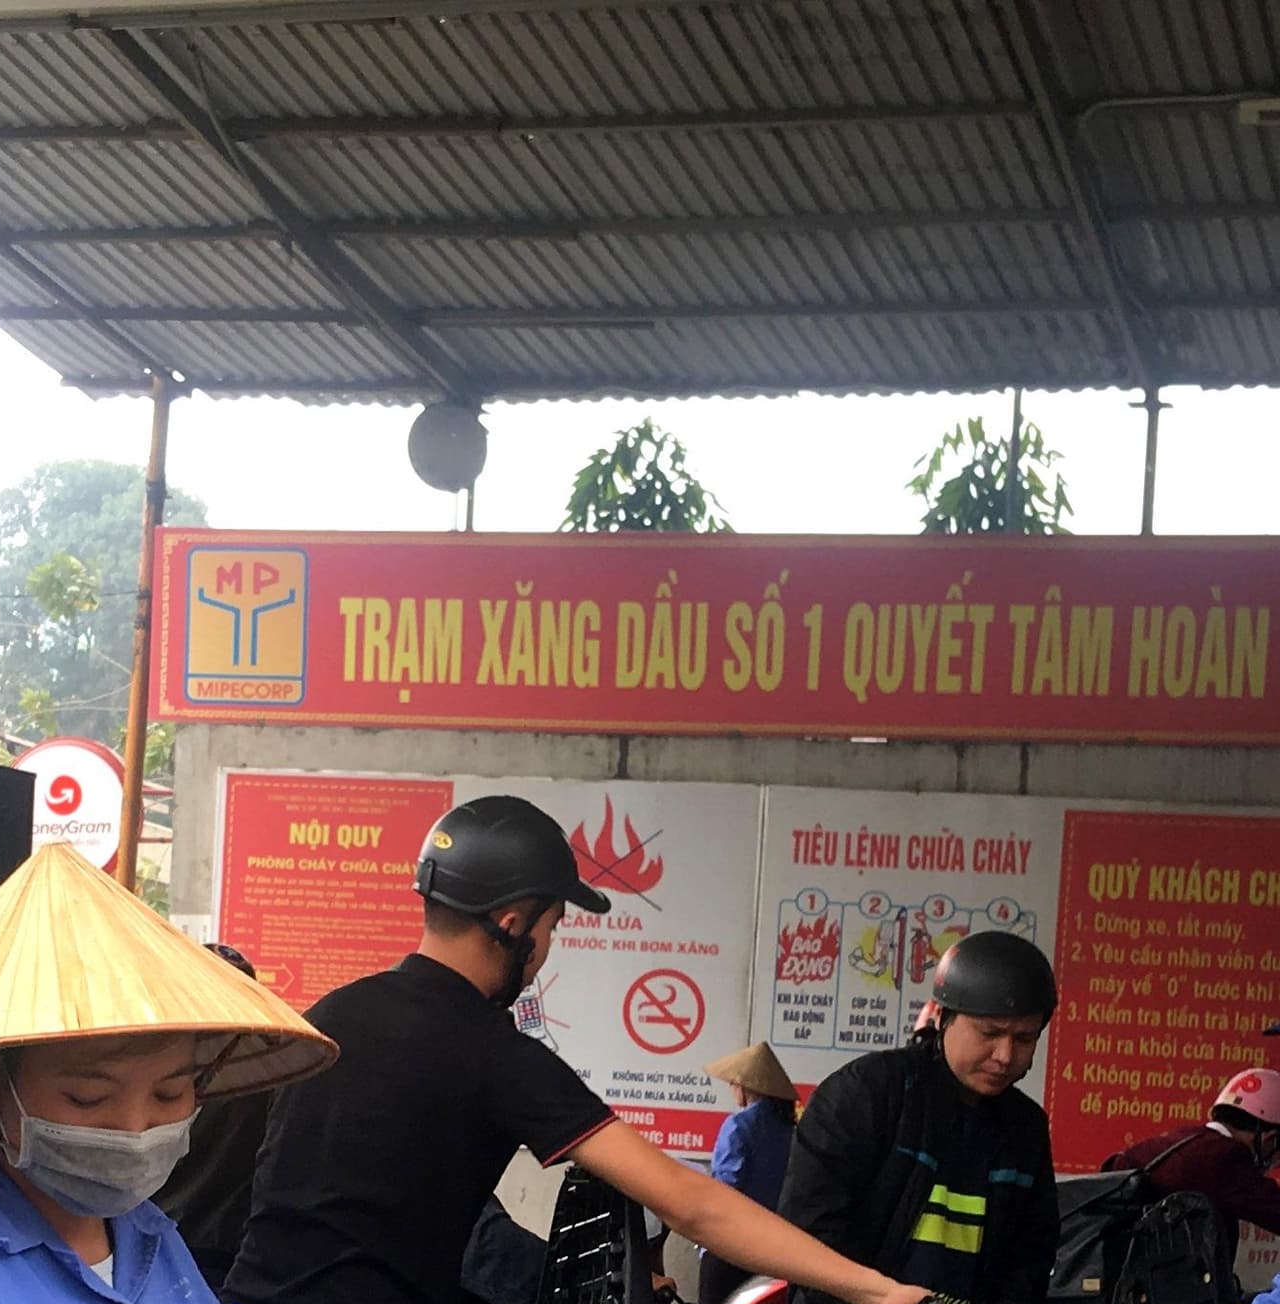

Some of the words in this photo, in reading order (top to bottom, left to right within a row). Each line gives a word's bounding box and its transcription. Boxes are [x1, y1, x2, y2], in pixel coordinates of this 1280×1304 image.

[340, 597, 463, 702] TRẠM
[476, 581, 601, 688] XĂNG
[616, 569, 708, 690] DẦU
[723, 568, 789, 691] SỐ
[804, 604, 823, 691] 1
[843, 570, 994, 703] QUYẾT
[1010, 585, 1113, 696] TÂM
[1128, 585, 1269, 698] HOÀN
[197, 681, 293, 699] MIPECORP
[32, 820, 112, 836] oneyGram
[289, 819, 329, 850] NỘI
[337, 824, 383, 849] QUY
[792, 823, 838, 866] TIÊU
[844, 826, 900, 875] LỆNH
[906, 827, 965, 873] CHỮA
[972, 832, 1032, 875] CHÁY
[248, 856, 295, 871] PHÒNG
[298, 858, 335, 872] CHÁY
[1148, 860, 1240, 905] KHÁCH
[807, 894, 816, 910] 1
[869, 897, 881, 914] 2
[933, 900, 946, 917] 3
[996, 903, 1010, 920] 4
[1074, 913, 1088, 930] 1.
[1177, 912, 1200, 936] tắt
[612, 940, 636, 953] KHI
[1092, 943, 1125, 964] Yêu
[1246, 981, 1274, 1001] khi
[1137, 1008, 1161, 1026] tra
[1085, 1032, 1113, 1052] khi
[1117, 1037, 1133, 1054] ra
